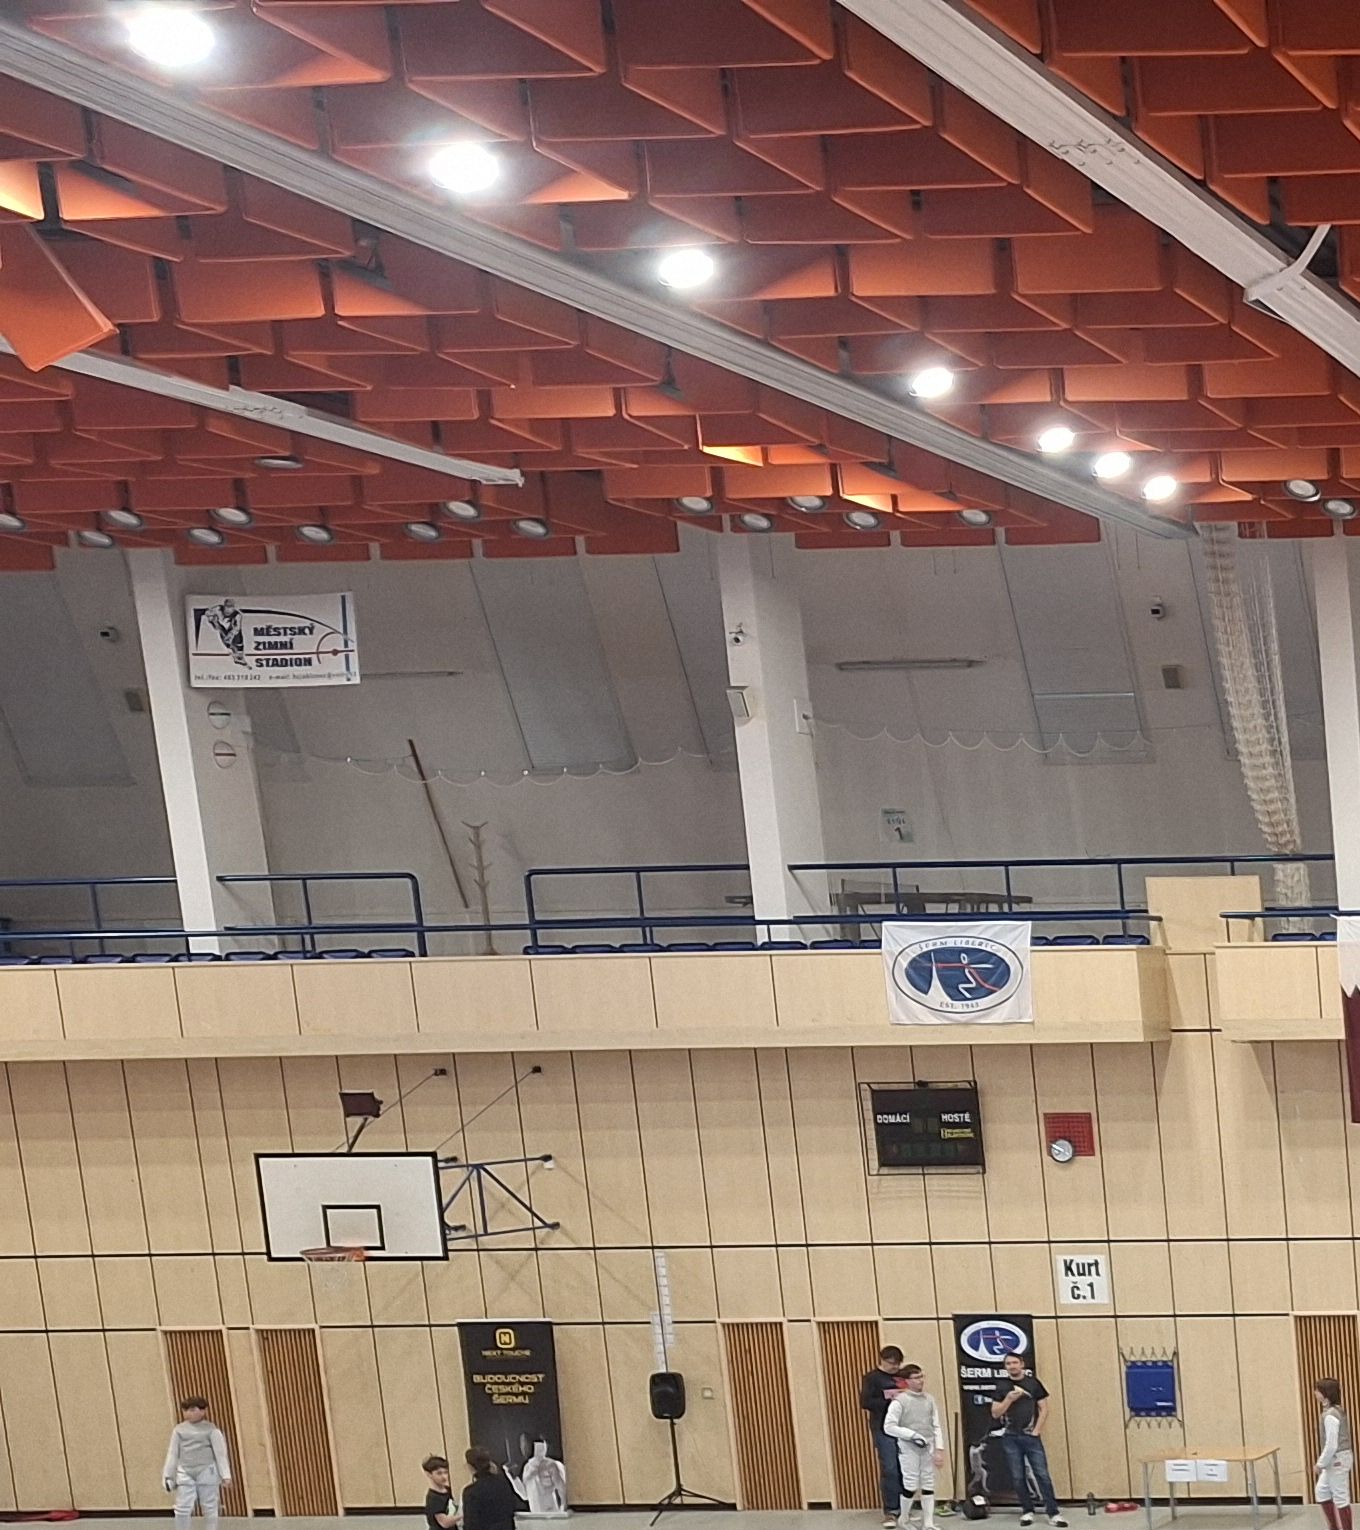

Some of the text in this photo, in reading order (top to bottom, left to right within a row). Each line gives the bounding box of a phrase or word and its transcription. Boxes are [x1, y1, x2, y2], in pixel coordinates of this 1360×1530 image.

[253, 623, 316, 637] MĚSTSKÝ
[254, 638, 294, 651] ZIMNÍ
[255, 657, 313, 668] STADION
[876, 1112, 910, 1124] DOMÁCÍ
[1063, 1258, 1101, 1278] Kurt
[1070, 1281, 1096, 1300] č.1
[960, 1366, 992, 1378] ŠERM
[472, 1374, 546, 1383] BUDOUCNOST
[485, 1384, 535, 1394] ČESKÉHO
